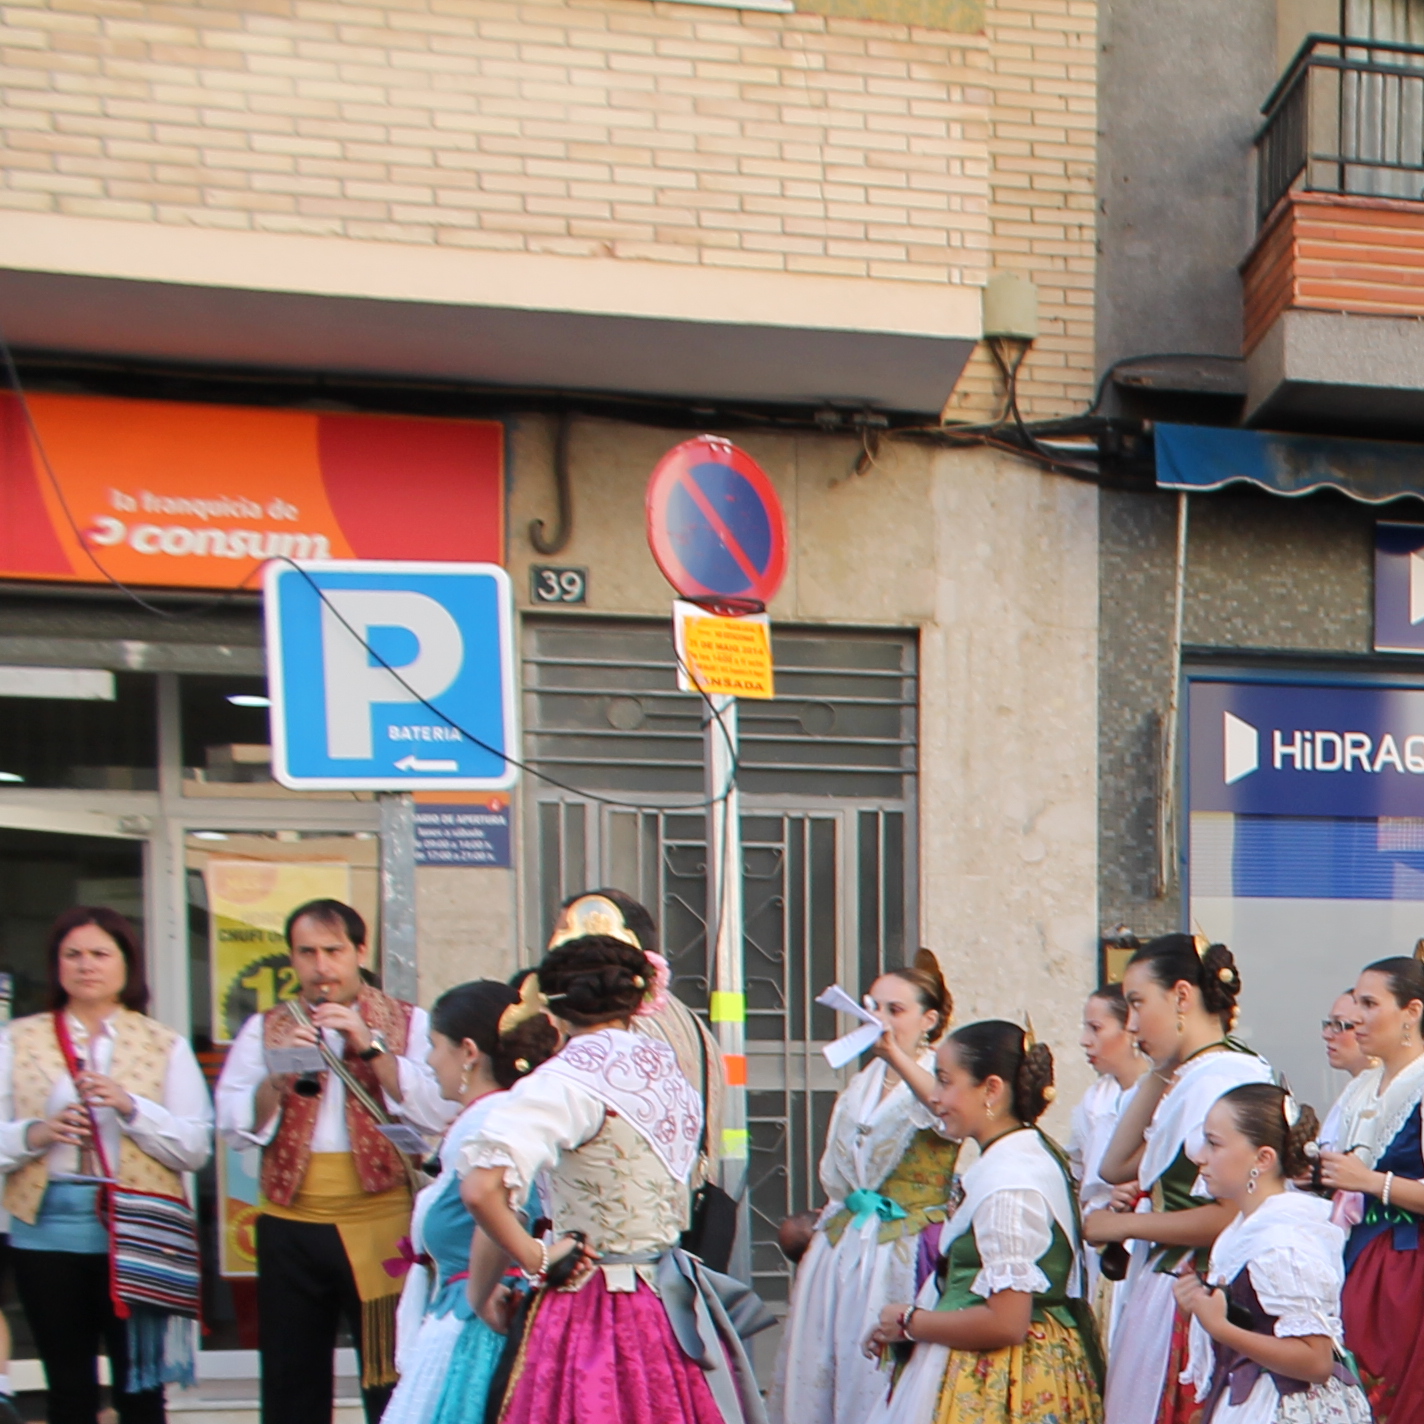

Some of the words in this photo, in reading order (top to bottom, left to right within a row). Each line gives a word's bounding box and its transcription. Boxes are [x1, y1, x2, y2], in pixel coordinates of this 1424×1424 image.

[139, 488, 264, 521] franquicia
[267, 497, 298, 521] de
[130, 522, 332, 559] consum
[537, 570, 583, 601] 39
[388, 724, 463, 743] BATERIA
